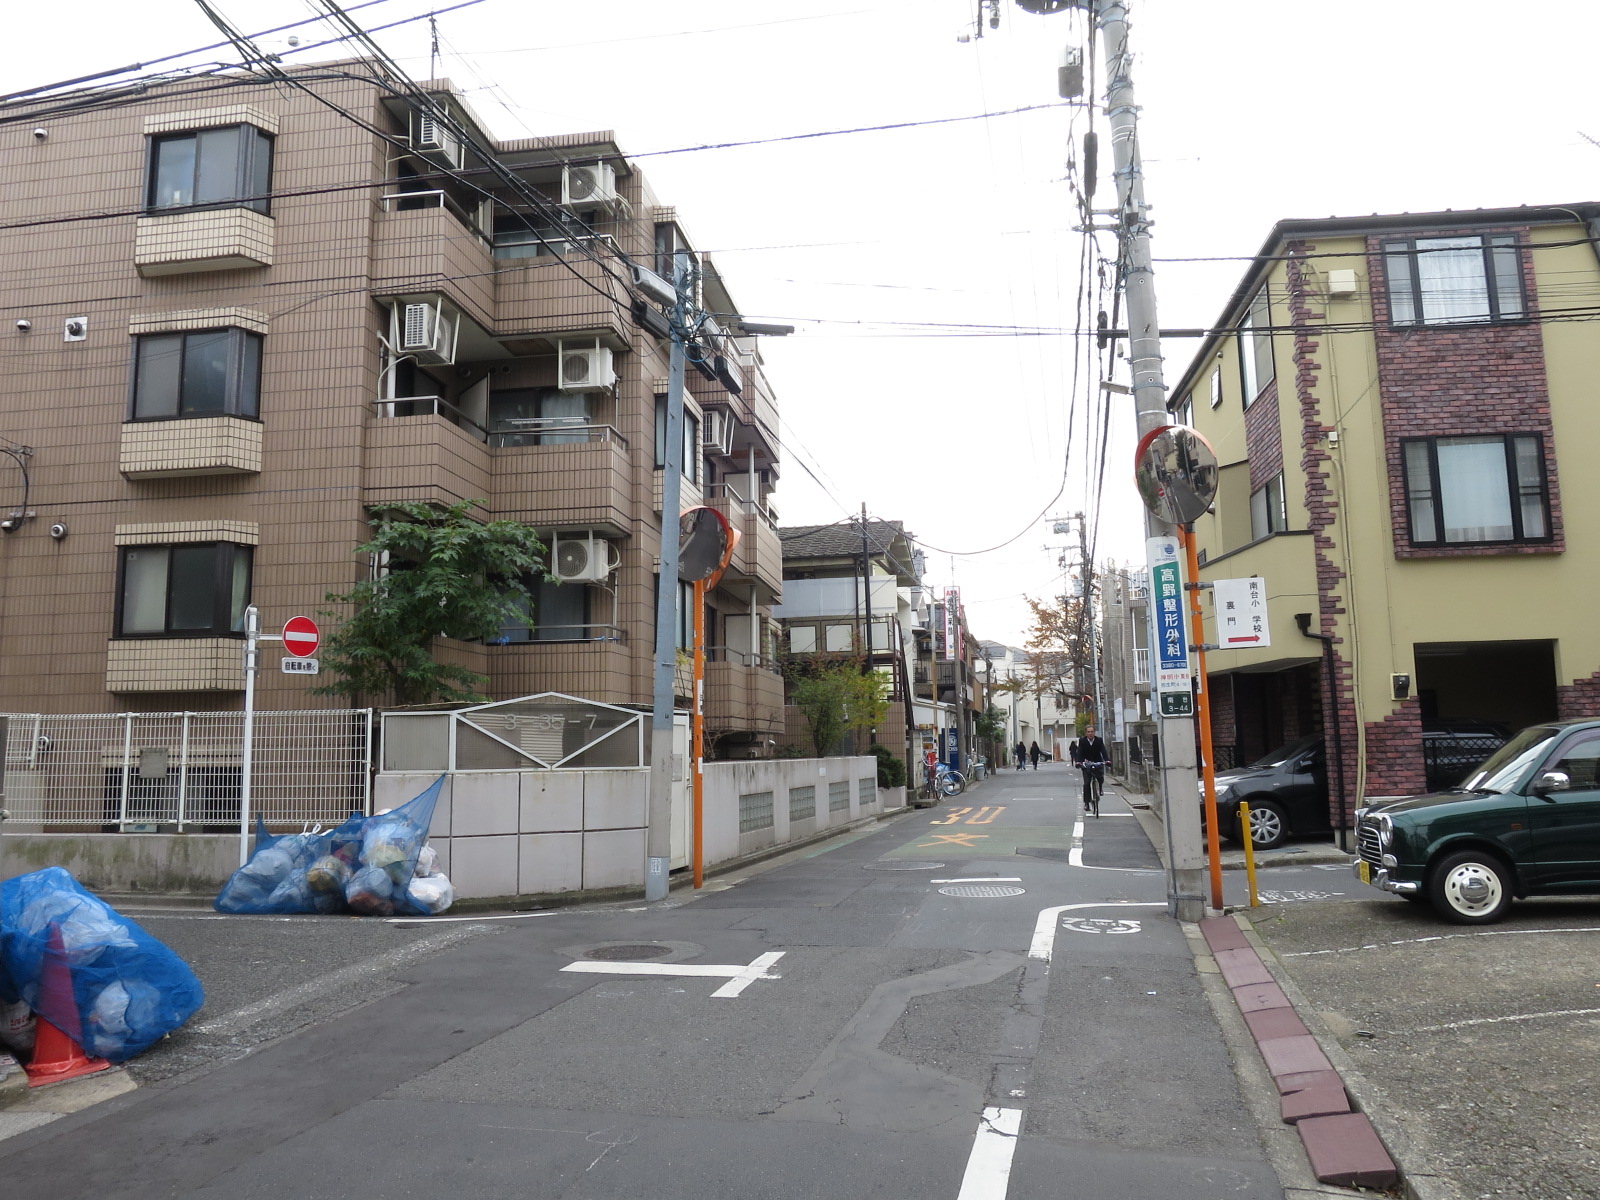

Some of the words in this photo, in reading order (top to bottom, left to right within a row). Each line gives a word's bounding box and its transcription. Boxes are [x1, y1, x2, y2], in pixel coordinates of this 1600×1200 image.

[1160, 568, 1181, 658] 高野整形外科
[1225, 601, 1237, 626] 裏門
[1249, 581, 1263, 634] 南台小学校
[285, 661, 316, 671] 自転車を除く
[929, 806, 1008, 825] 30
